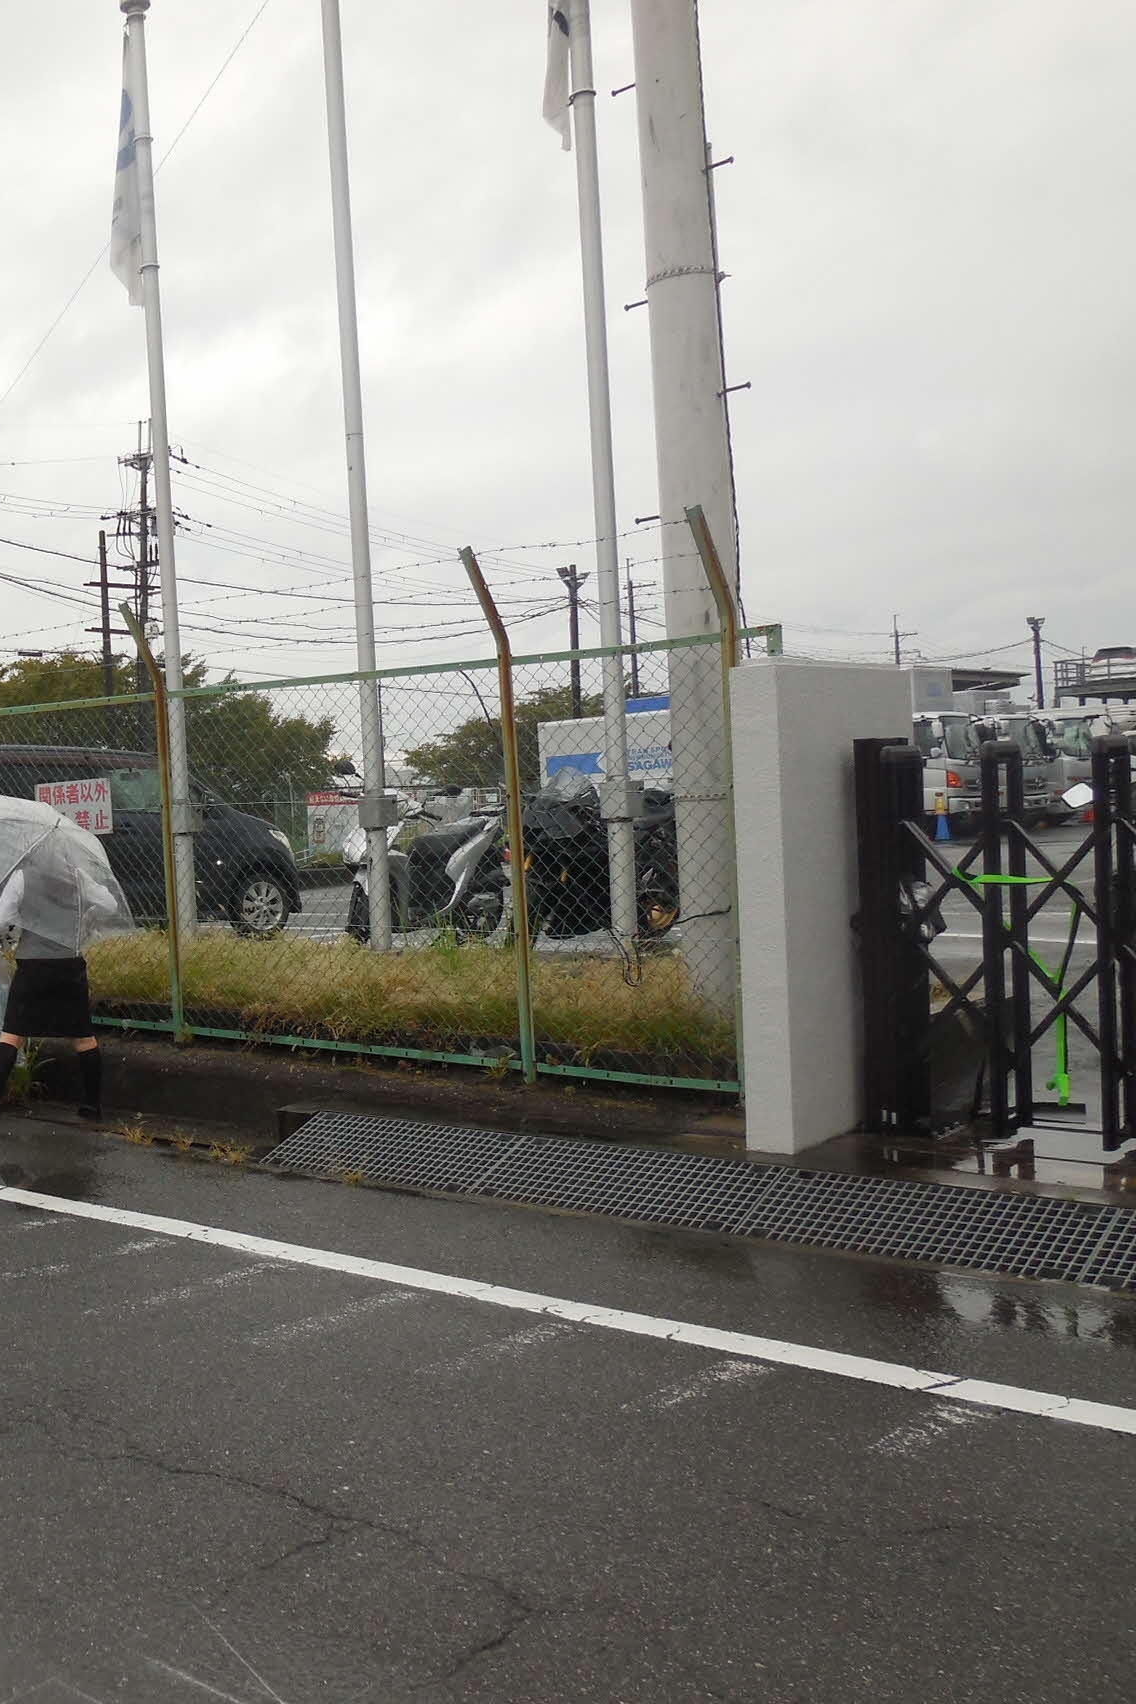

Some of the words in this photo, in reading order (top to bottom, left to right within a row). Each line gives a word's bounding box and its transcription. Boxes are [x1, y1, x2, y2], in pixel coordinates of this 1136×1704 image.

[39, 781, 108, 805] 関係者以外
[62, 810, 109, 830] 禁止
